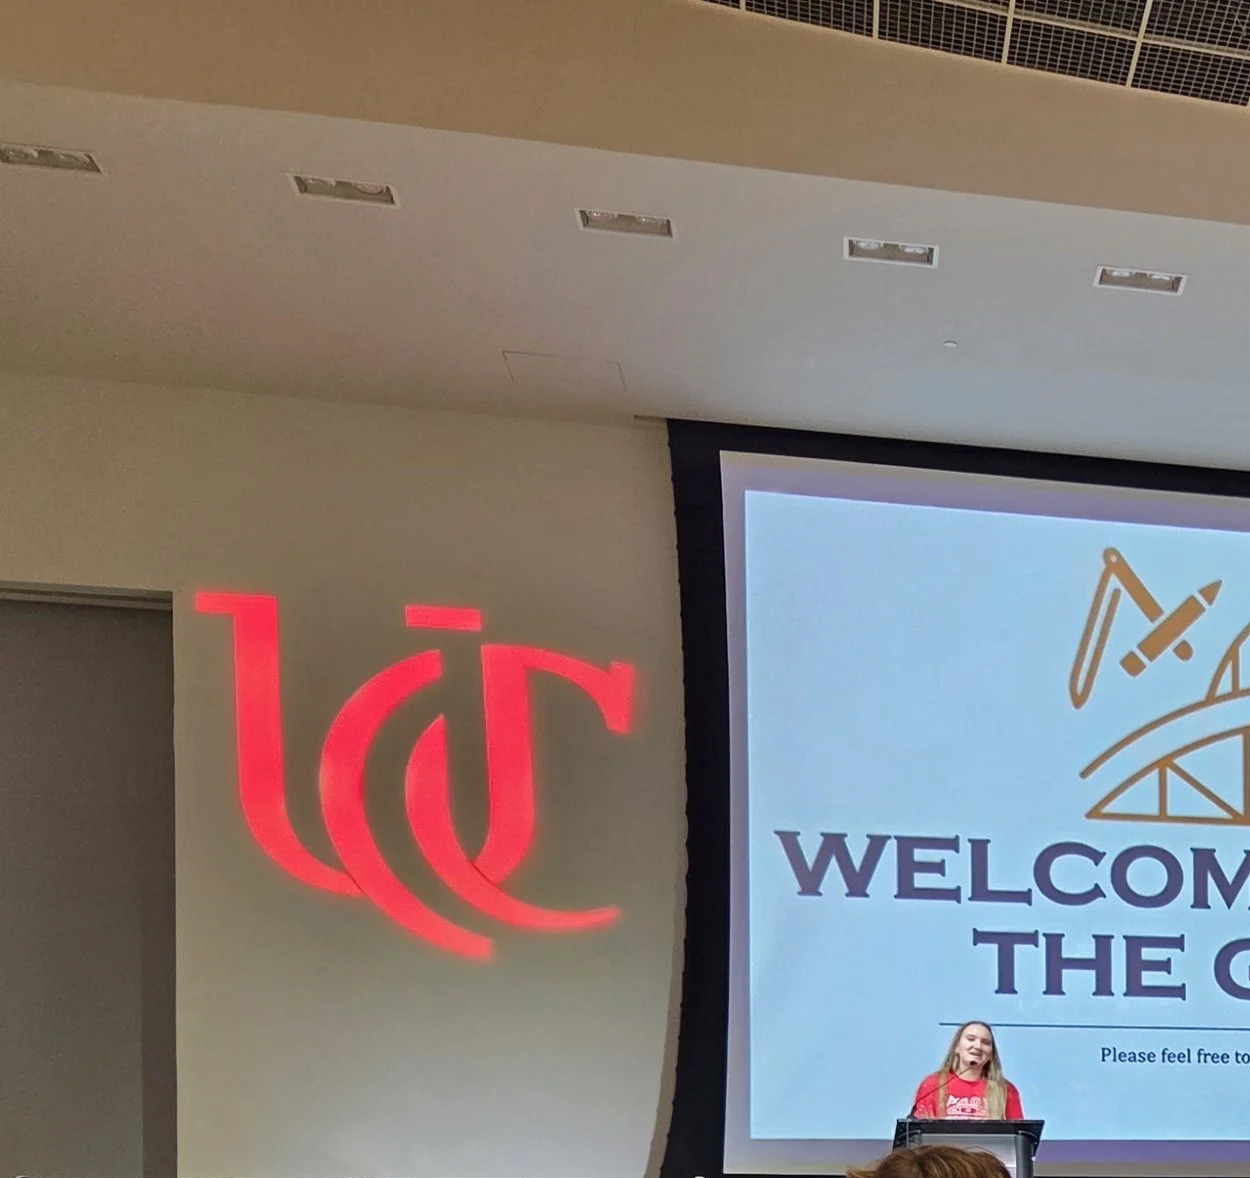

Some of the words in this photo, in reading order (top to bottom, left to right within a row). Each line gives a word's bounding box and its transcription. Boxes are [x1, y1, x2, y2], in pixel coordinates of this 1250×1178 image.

[973, 928, 1188, 1001] THE
[1101, 1046, 1156, 1063] Please
[1161, 1047, 1192, 1063] feel
[1196, 1048, 1230, 1065] free
[1234, 1051, 1250, 1065] to
